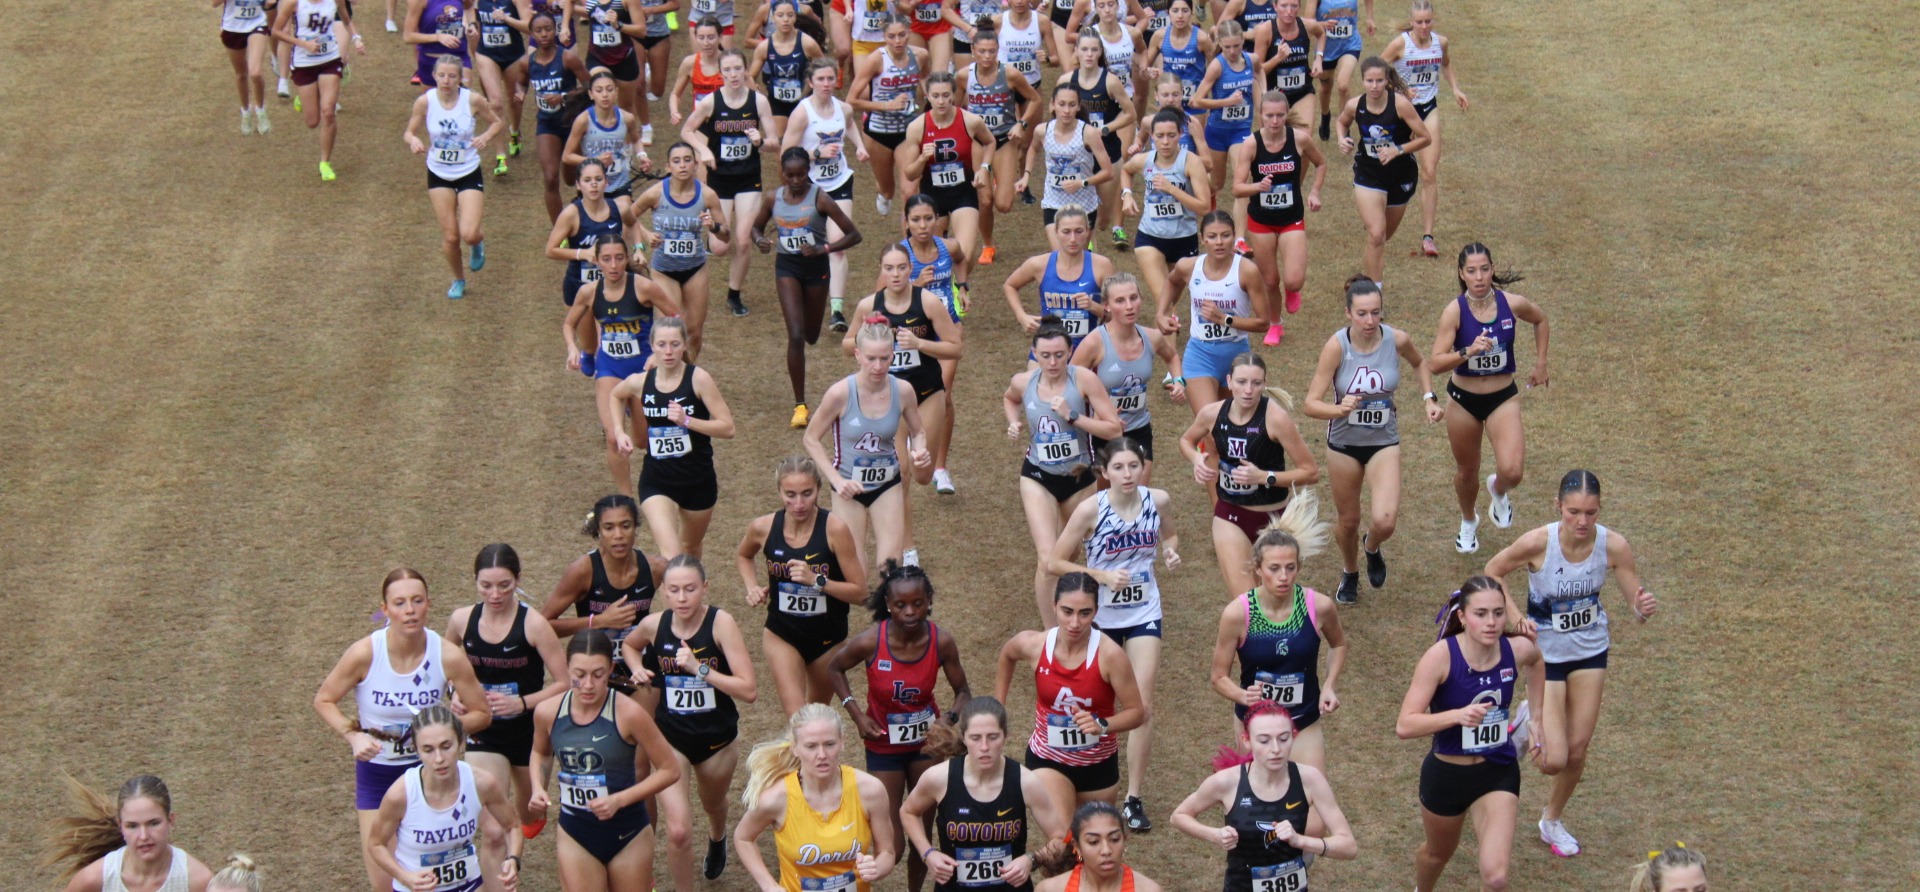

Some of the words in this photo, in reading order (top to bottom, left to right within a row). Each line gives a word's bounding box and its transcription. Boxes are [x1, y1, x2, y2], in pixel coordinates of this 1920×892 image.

[240, 7, 256, 17] 217
[918, 9, 938, 20] 304
[1150, 18, 1167, 29] 291
[486, 34, 506, 45] 452
[598, 33, 616, 43] 145
[1106, 51, 1131, 60] ILLIAM
[1163, 57, 1197, 65] OKLAHOMA
[1283, 75, 1300, 87] 170
[1416, 72, 1432, 83] 179
[778, 88, 796, 99] 367
[1226, 106, 1246, 119] 354
[714, 118, 758, 132] COYOTES
[439, 150, 459, 161] 427
[725, 145, 747, 157] 269
[820, 165, 839, 177] 265
[1258, 161, 1295, 175] RAIDERS
[938, 171, 958, 184] 116
[1265, 192, 1288, 205] 424
[1154, 204, 1176, 216] 156
[652, 215, 702, 232] SAINT
[669, 241, 693, 254] 369
[786, 237, 808, 249] 476
[1204, 324, 1231, 338] 382
[607, 343, 633, 355] 480
[1475, 356, 1501, 369] 139
[1346, 366, 1392, 395] AQ
[1117, 396, 1139, 410] 104
[1356, 410, 1383, 424] 109
[655, 437, 685, 455] 255
[854, 432, 888, 455] AQ
[1228, 437, 1248, 459] M
[1044, 443, 1072, 460] 106
[860, 468, 887, 483] 103
[1106, 531, 1156, 554] MNU
[1111, 585, 1143, 604] 295
[1558, 579, 1593, 598] MBU
[787, 595, 818, 612] 267
[1559, 608, 1592, 631] 306
[372, 689, 440, 707] TAYLOR
[674, 690, 706, 709] 270
[892, 680, 921, 705] LC
[1263, 683, 1295, 704] 378
[1050, 686, 1093, 717] AC
[898, 720, 929, 743] 279
[1059, 728, 1088, 746] 111
[1471, 724, 1501, 746] 140
[413, 818, 476, 845] TAYLOR
[946, 818, 1022, 842] COYOTES
[432, 860, 467, 884] 458
[965, 860, 1005, 881] 268
[1261, 872, 1299, 892] 389
